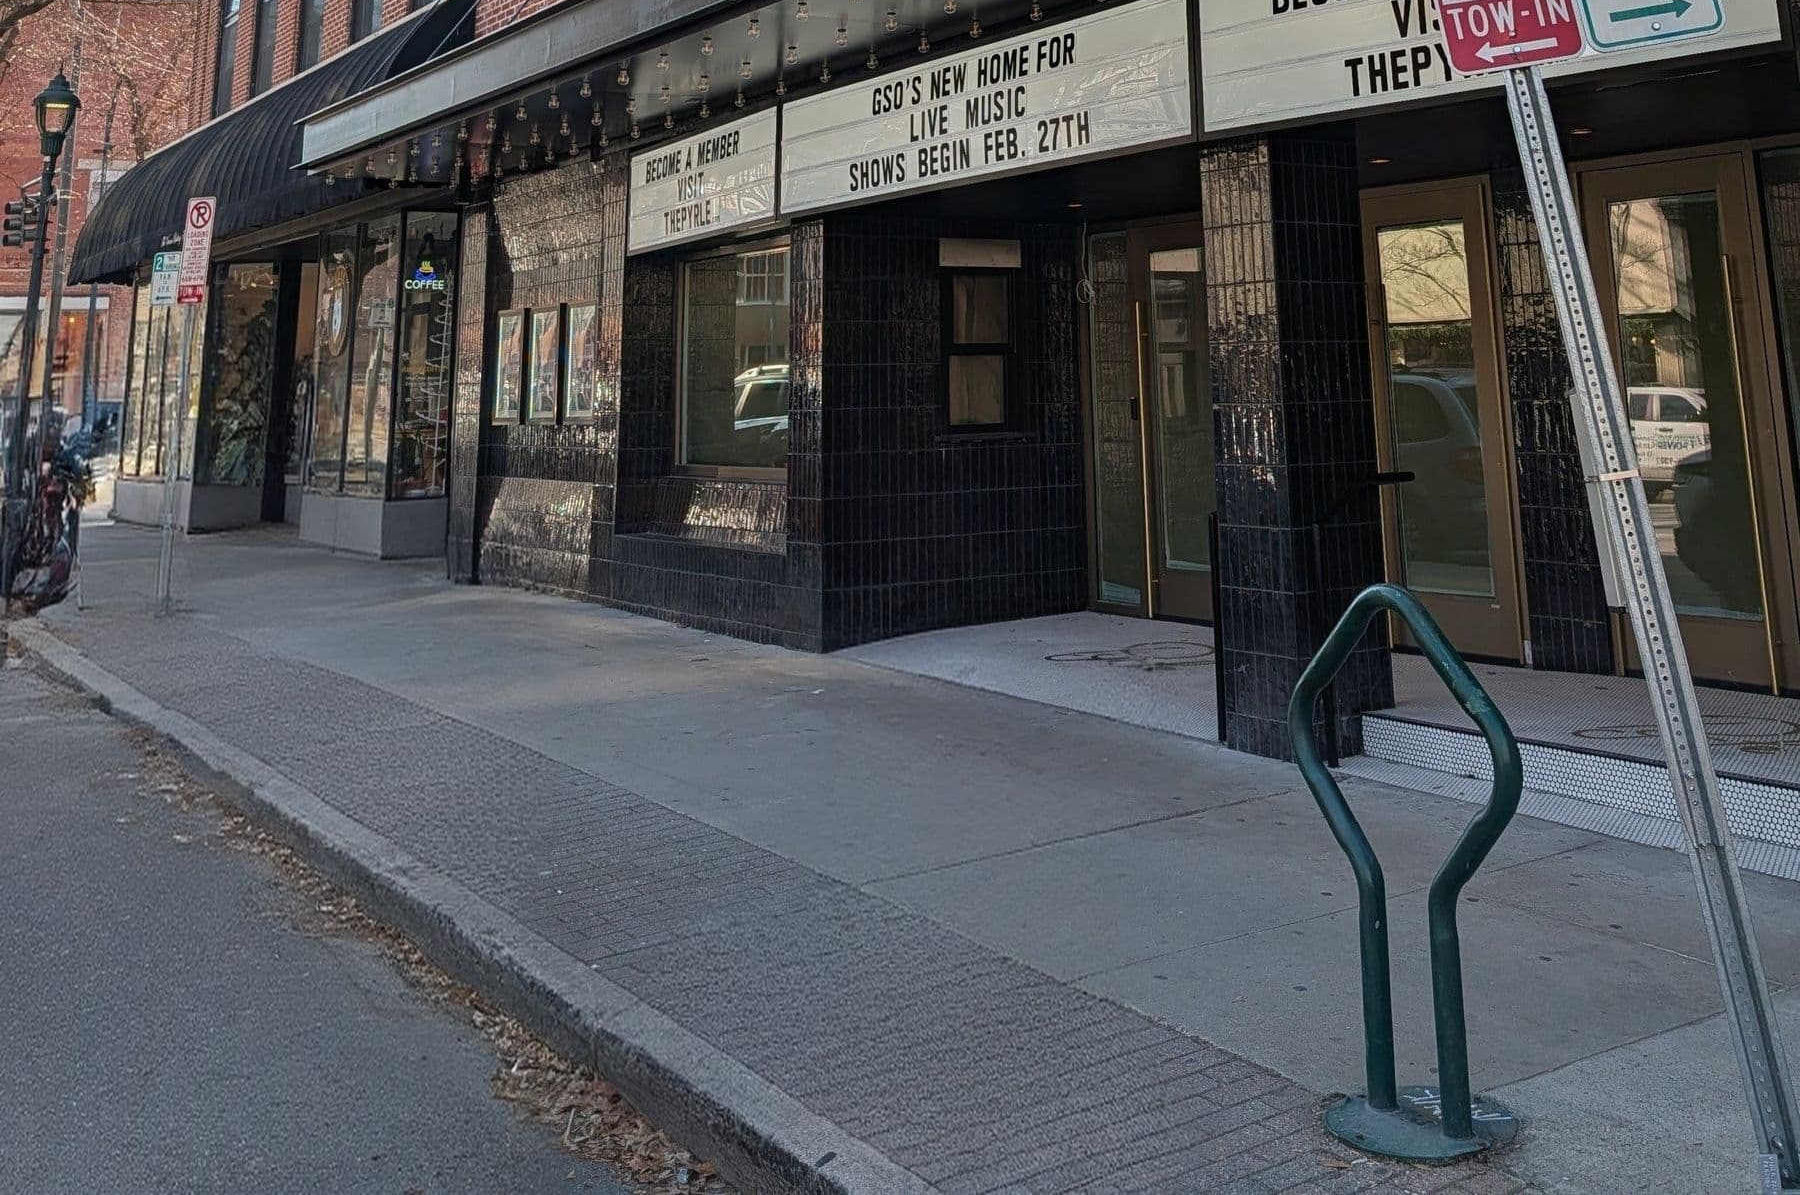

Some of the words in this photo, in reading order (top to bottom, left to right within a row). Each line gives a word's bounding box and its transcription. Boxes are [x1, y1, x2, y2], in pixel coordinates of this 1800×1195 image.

[872, 75, 922, 116] GSO'S
[930, 62, 967, 100] NEW
[977, 44, 1029, 88] HOME
[1037, 32, 1075, 73] FOR
[910, 105, 948, 142] LIVE
[966, 85, 1026, 129] MUSIC
[646, 149, 682, 184] BECOME
[685, 146, 692, 171] A
[697, 130, 740, 167] MEMBER
[849, 153, 905, 192] SHOWS
[918, 138, 970, 178] BEGIN
[983, 127, 1026, 165] FEB.
[1037, 111, 1090, 153] 27TH
[677, 172, 704, 202] VISIT
[155, 256, 163, 271] 2
[405, 279, 445, 290] COFFEE
